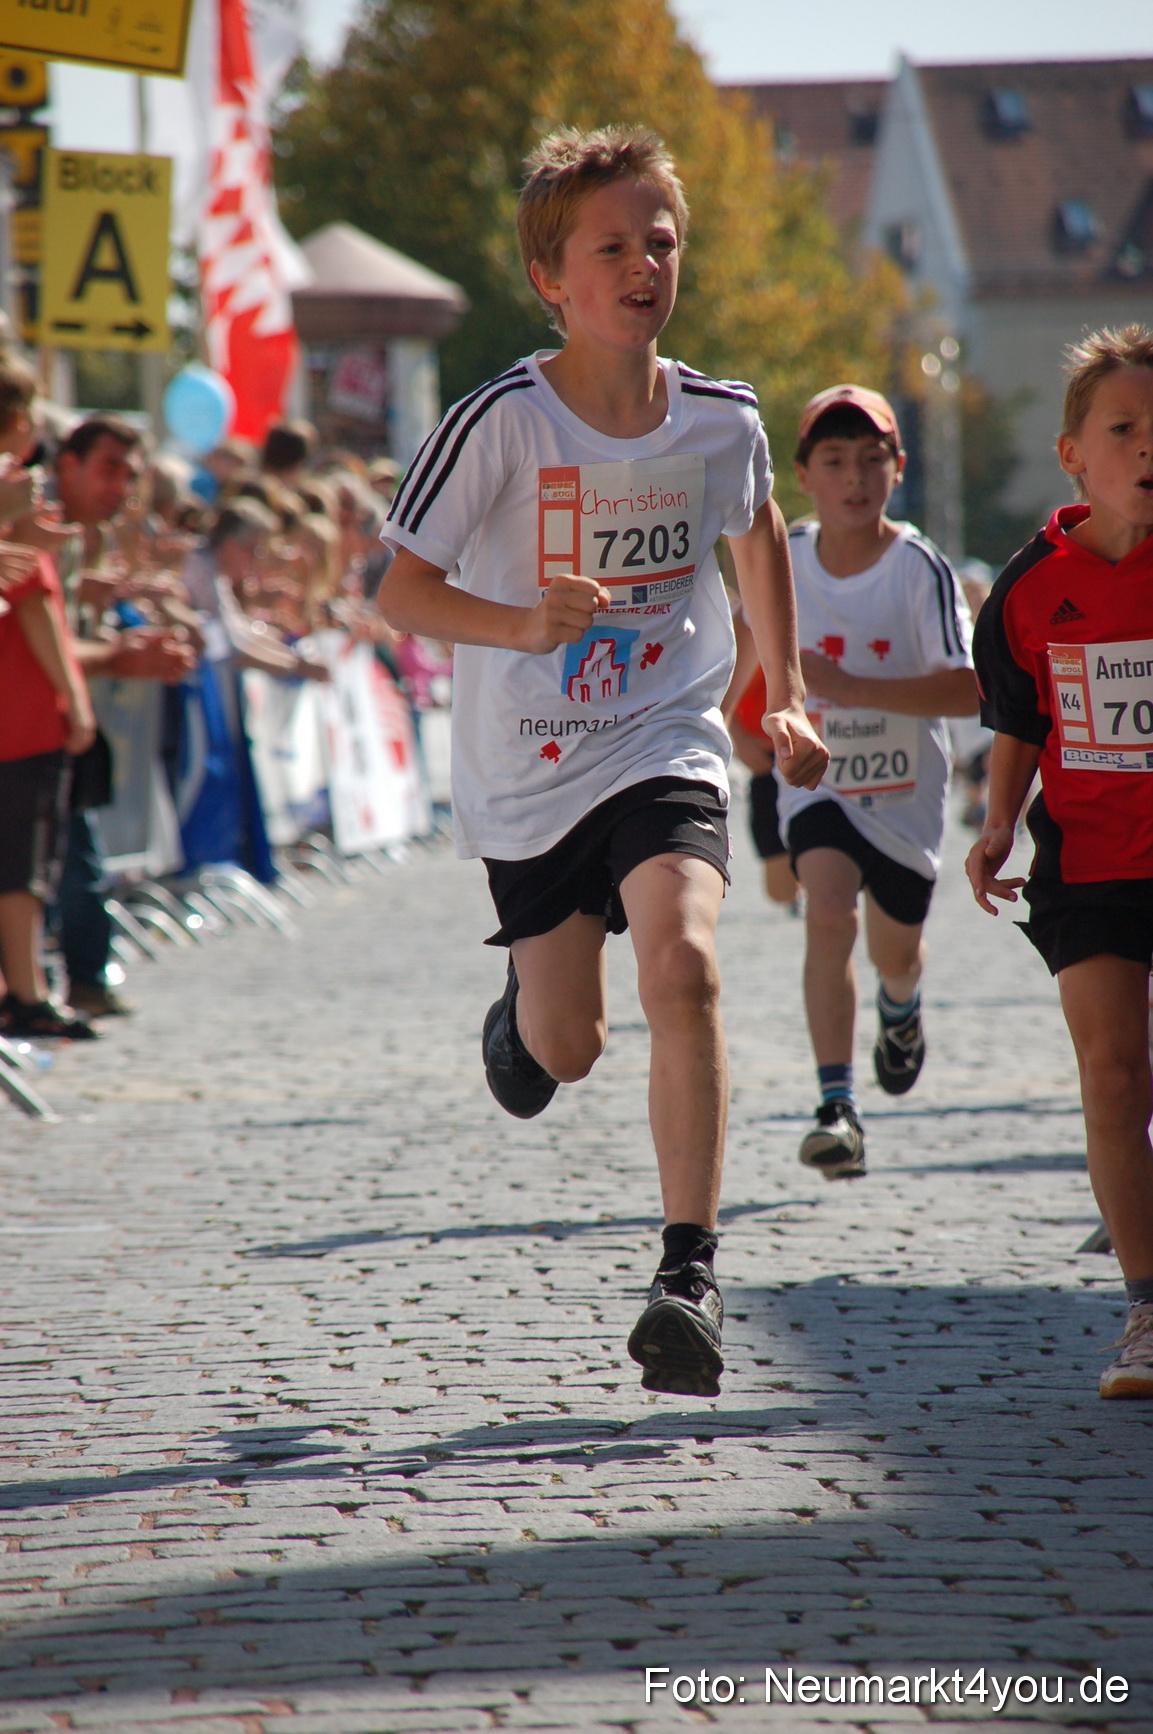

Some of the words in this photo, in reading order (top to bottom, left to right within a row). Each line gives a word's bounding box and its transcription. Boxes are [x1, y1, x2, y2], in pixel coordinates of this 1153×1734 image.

[57, 157, 158, 194] Block
[71, 211, 139, 303] A
[580, 485, 688, 516] Christian
[593, 520, 690, 570] 7203
[649, 575, 694, 596] PFLEIDERER
[1060, 692, 1081, 711] K4
[826, 716, 886, 740] Michael
[831, 750, 909, 784] 7020
[1063, 749, 1124, 765] BOCK
